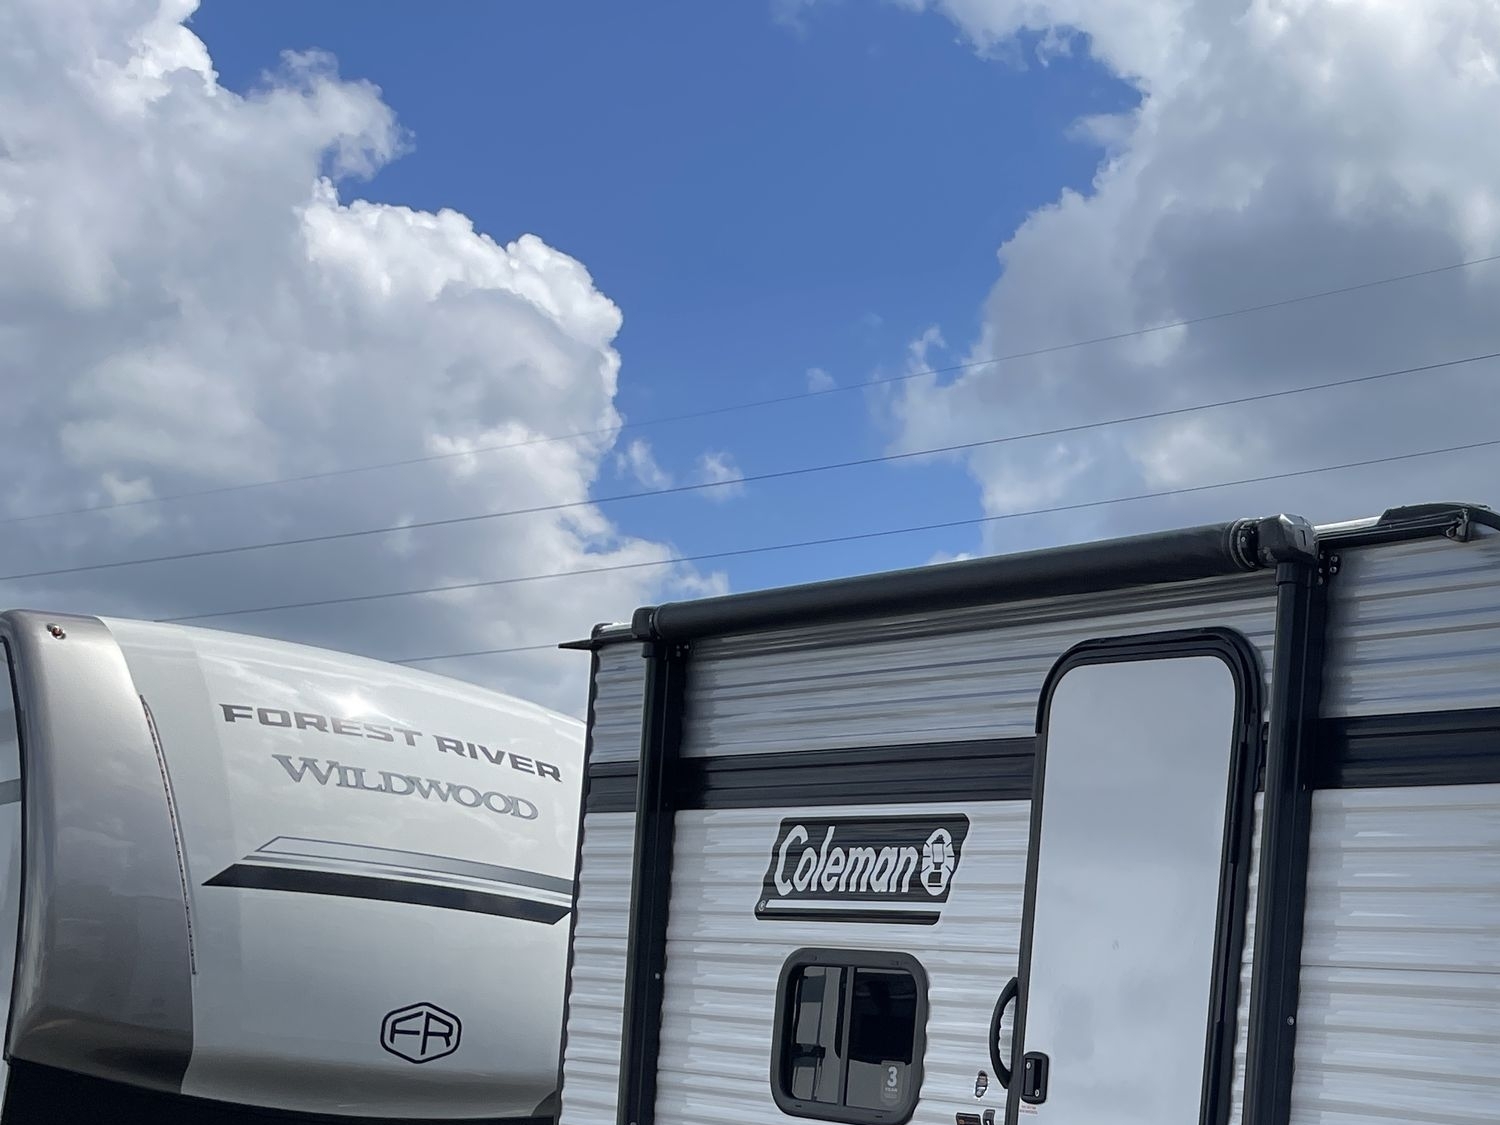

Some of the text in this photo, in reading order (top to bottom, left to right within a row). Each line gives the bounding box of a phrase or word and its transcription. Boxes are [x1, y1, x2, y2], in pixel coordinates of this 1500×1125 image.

[219, 703, 563, 783] FOREST RIVER
[272, 753, 539, 821] WILDWOOD
[774, 825, 919, 896] Coleman
[389, 1010, 454, 1056] FR
[887, 1066, 898, 1087] 3
